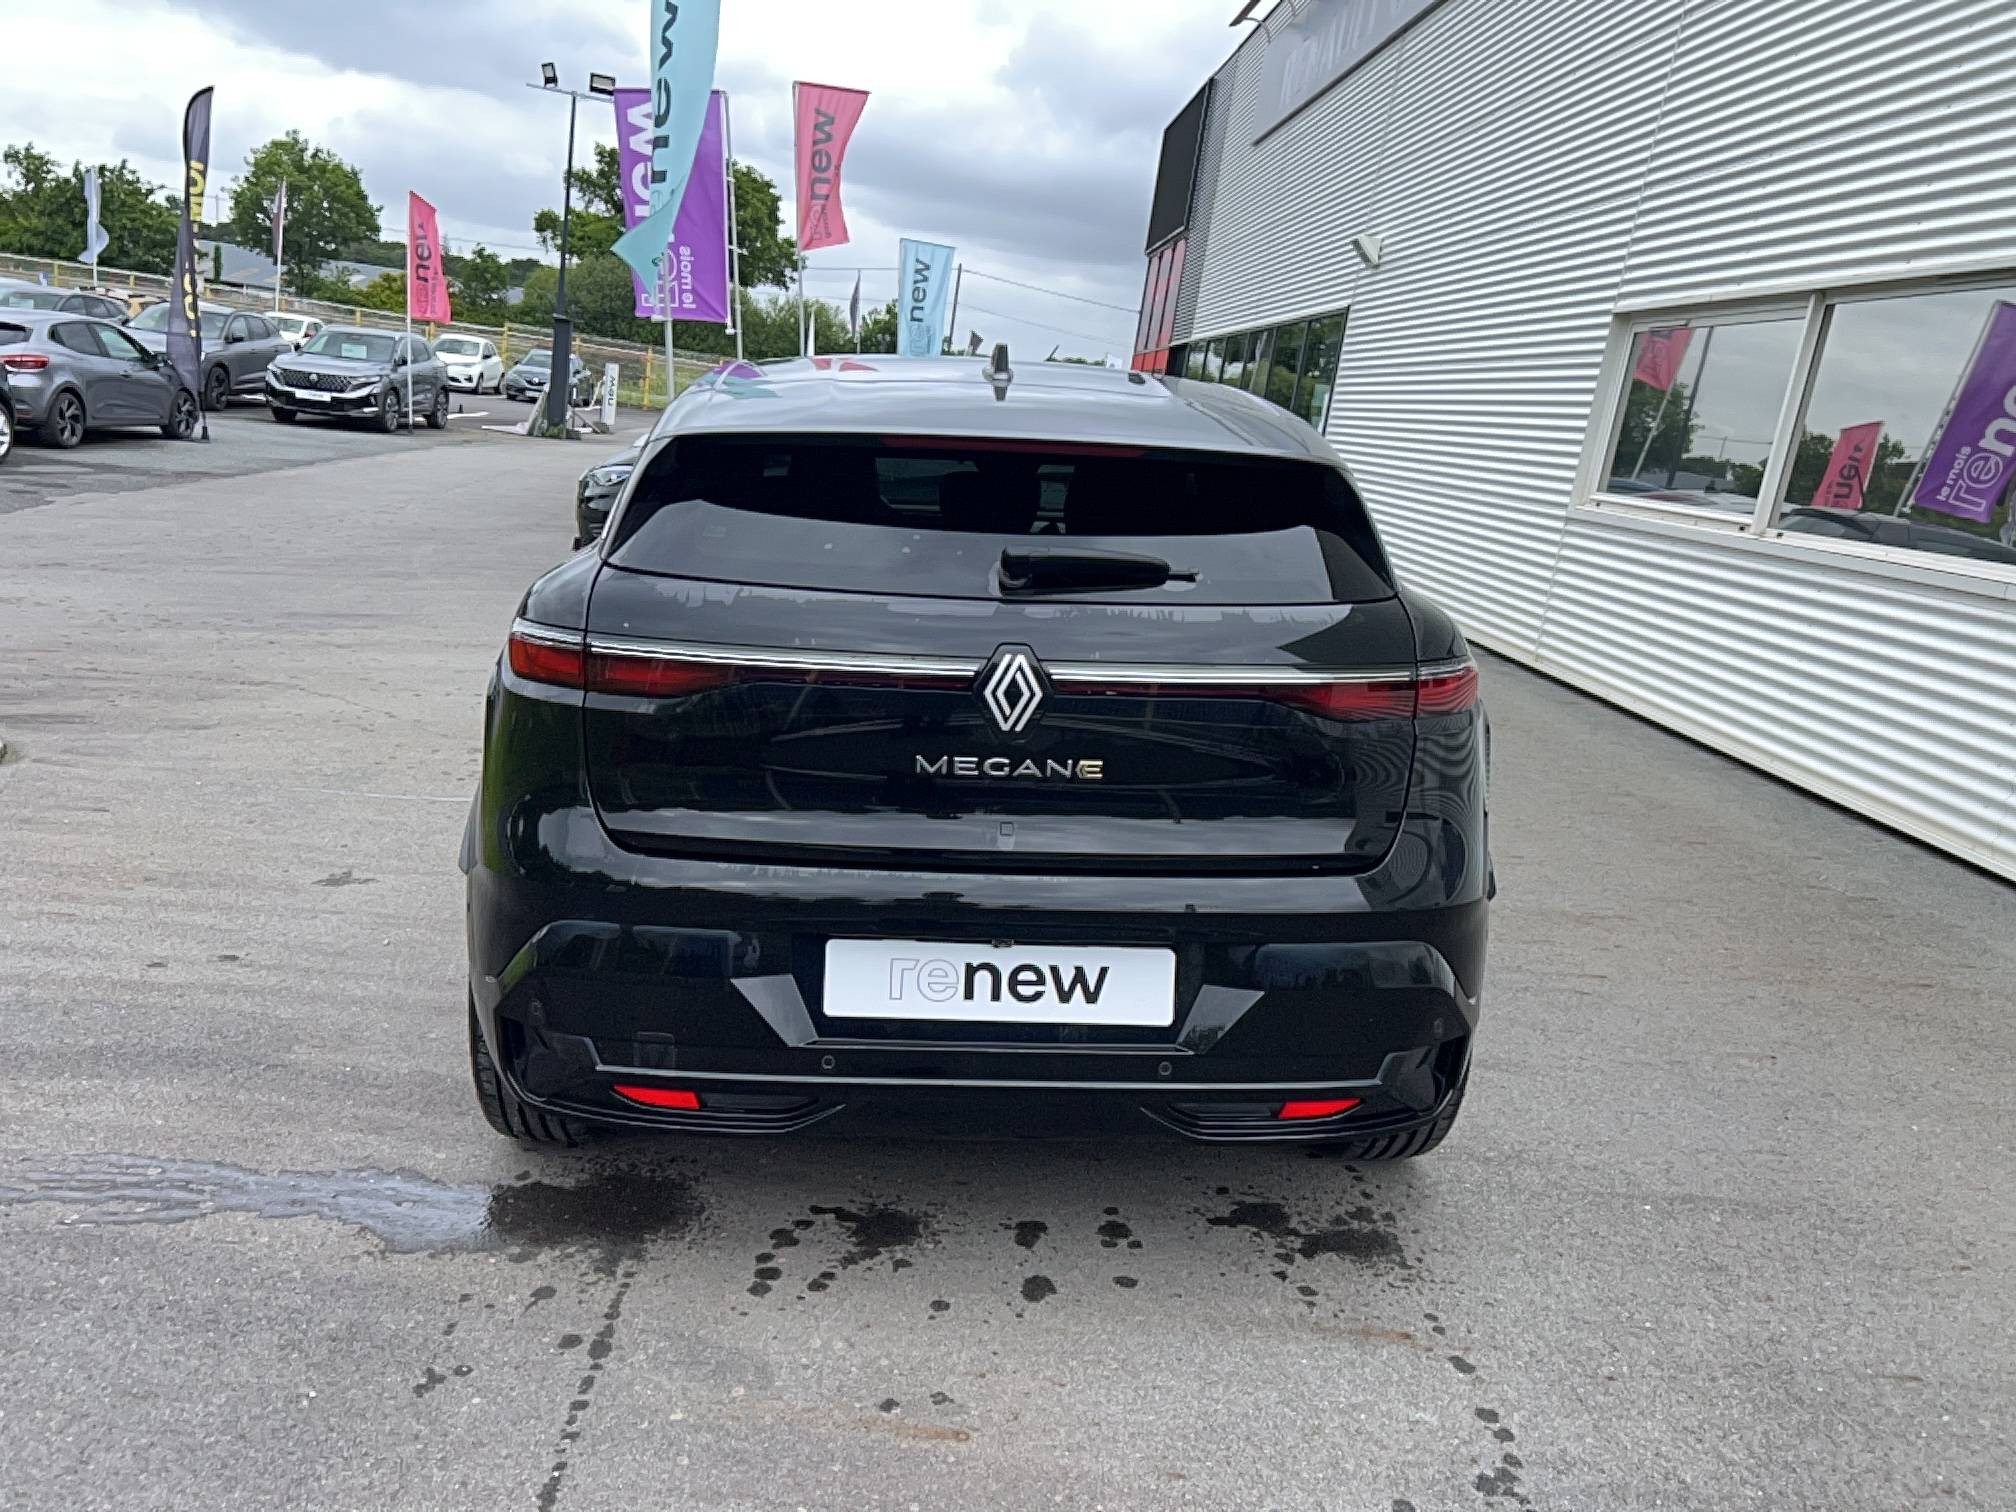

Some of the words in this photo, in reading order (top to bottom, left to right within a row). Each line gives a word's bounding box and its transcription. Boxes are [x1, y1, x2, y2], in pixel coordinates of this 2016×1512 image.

[1946, 446, 1972, 485] mois
[1949, 383, 2016, 512] ren
[915, 754, 1104, 780] MEGANE
[889, 957, 1110, 1005] renew
